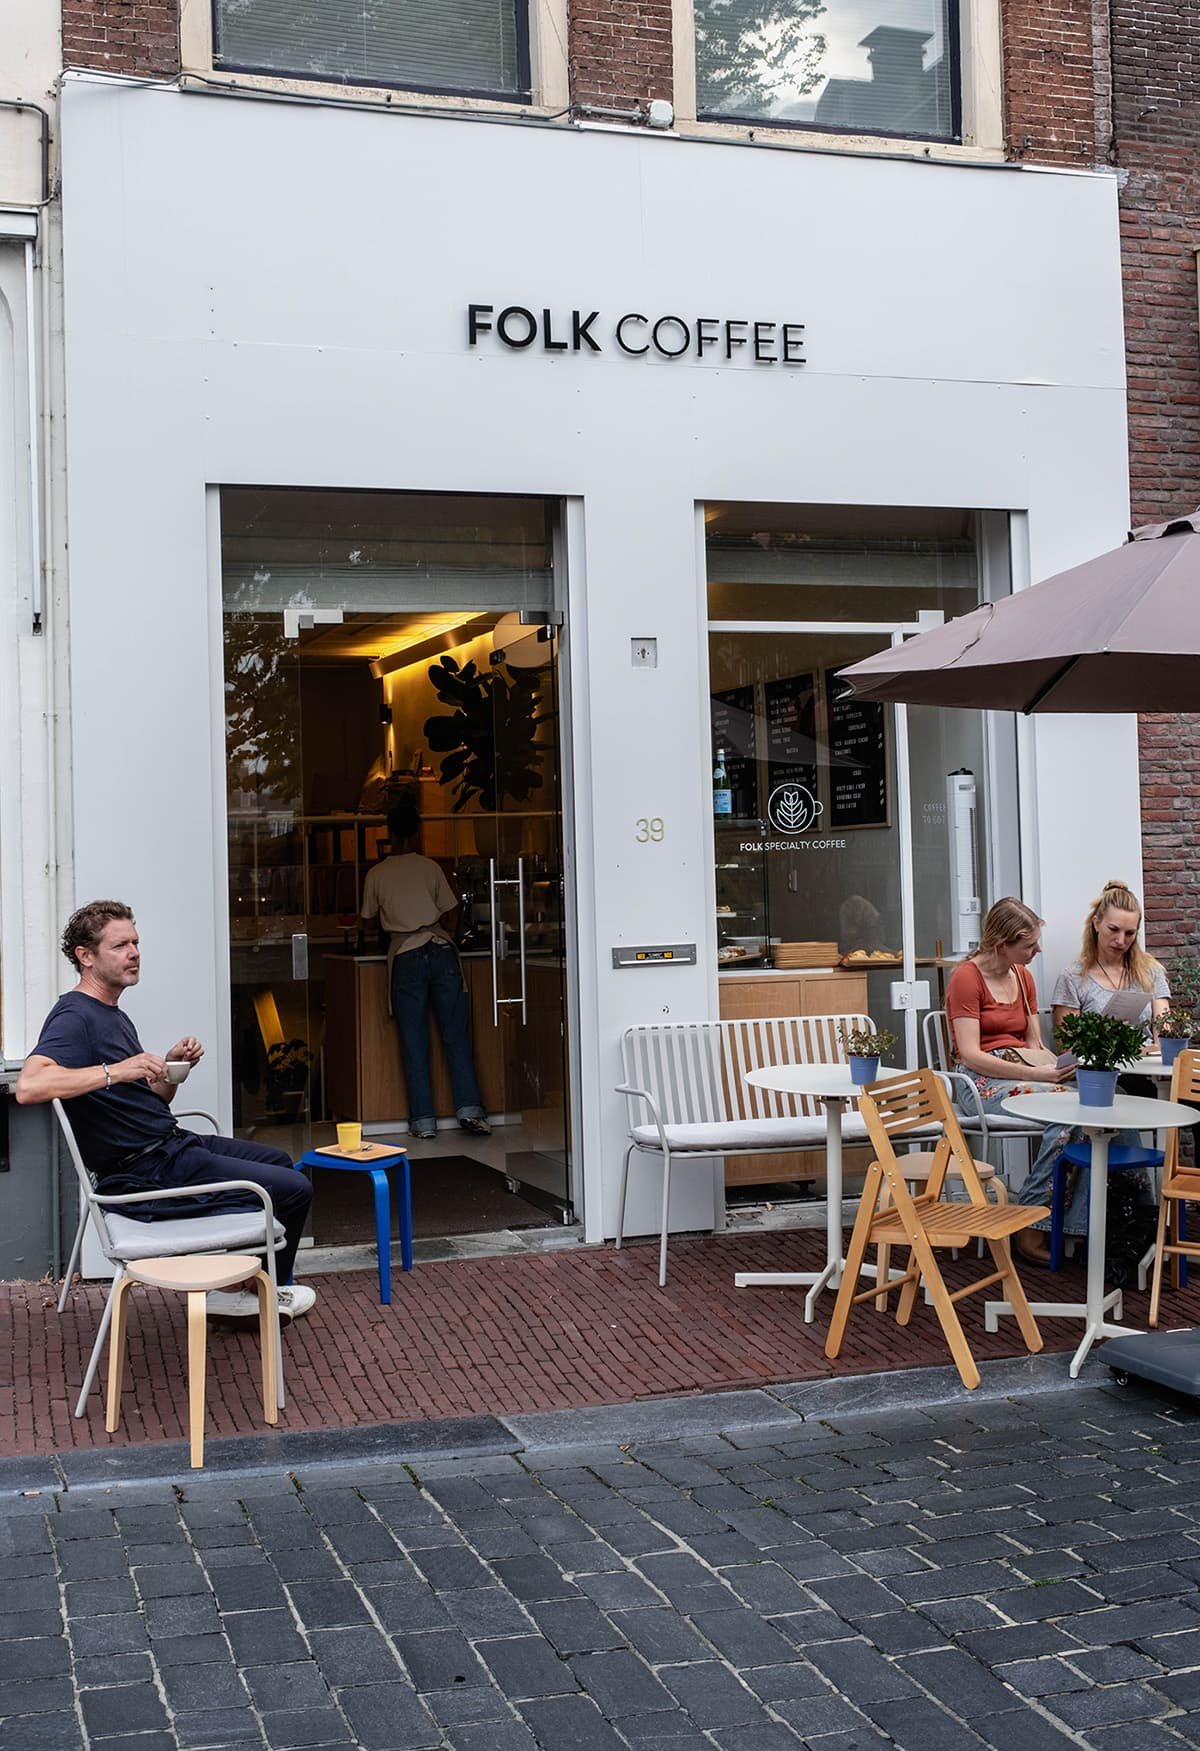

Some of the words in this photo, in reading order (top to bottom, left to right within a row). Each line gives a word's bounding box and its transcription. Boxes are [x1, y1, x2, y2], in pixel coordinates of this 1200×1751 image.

[468, 304, 602, 351] FOLK
[616, 313, 806, 363] COFFEE
[635, 818, 664, 843] 39
[740, 843, 764, 852] FOLK
[764, 841, 811, 851] SPECIALTY
[812, 839, 846, 849] COFFEE
